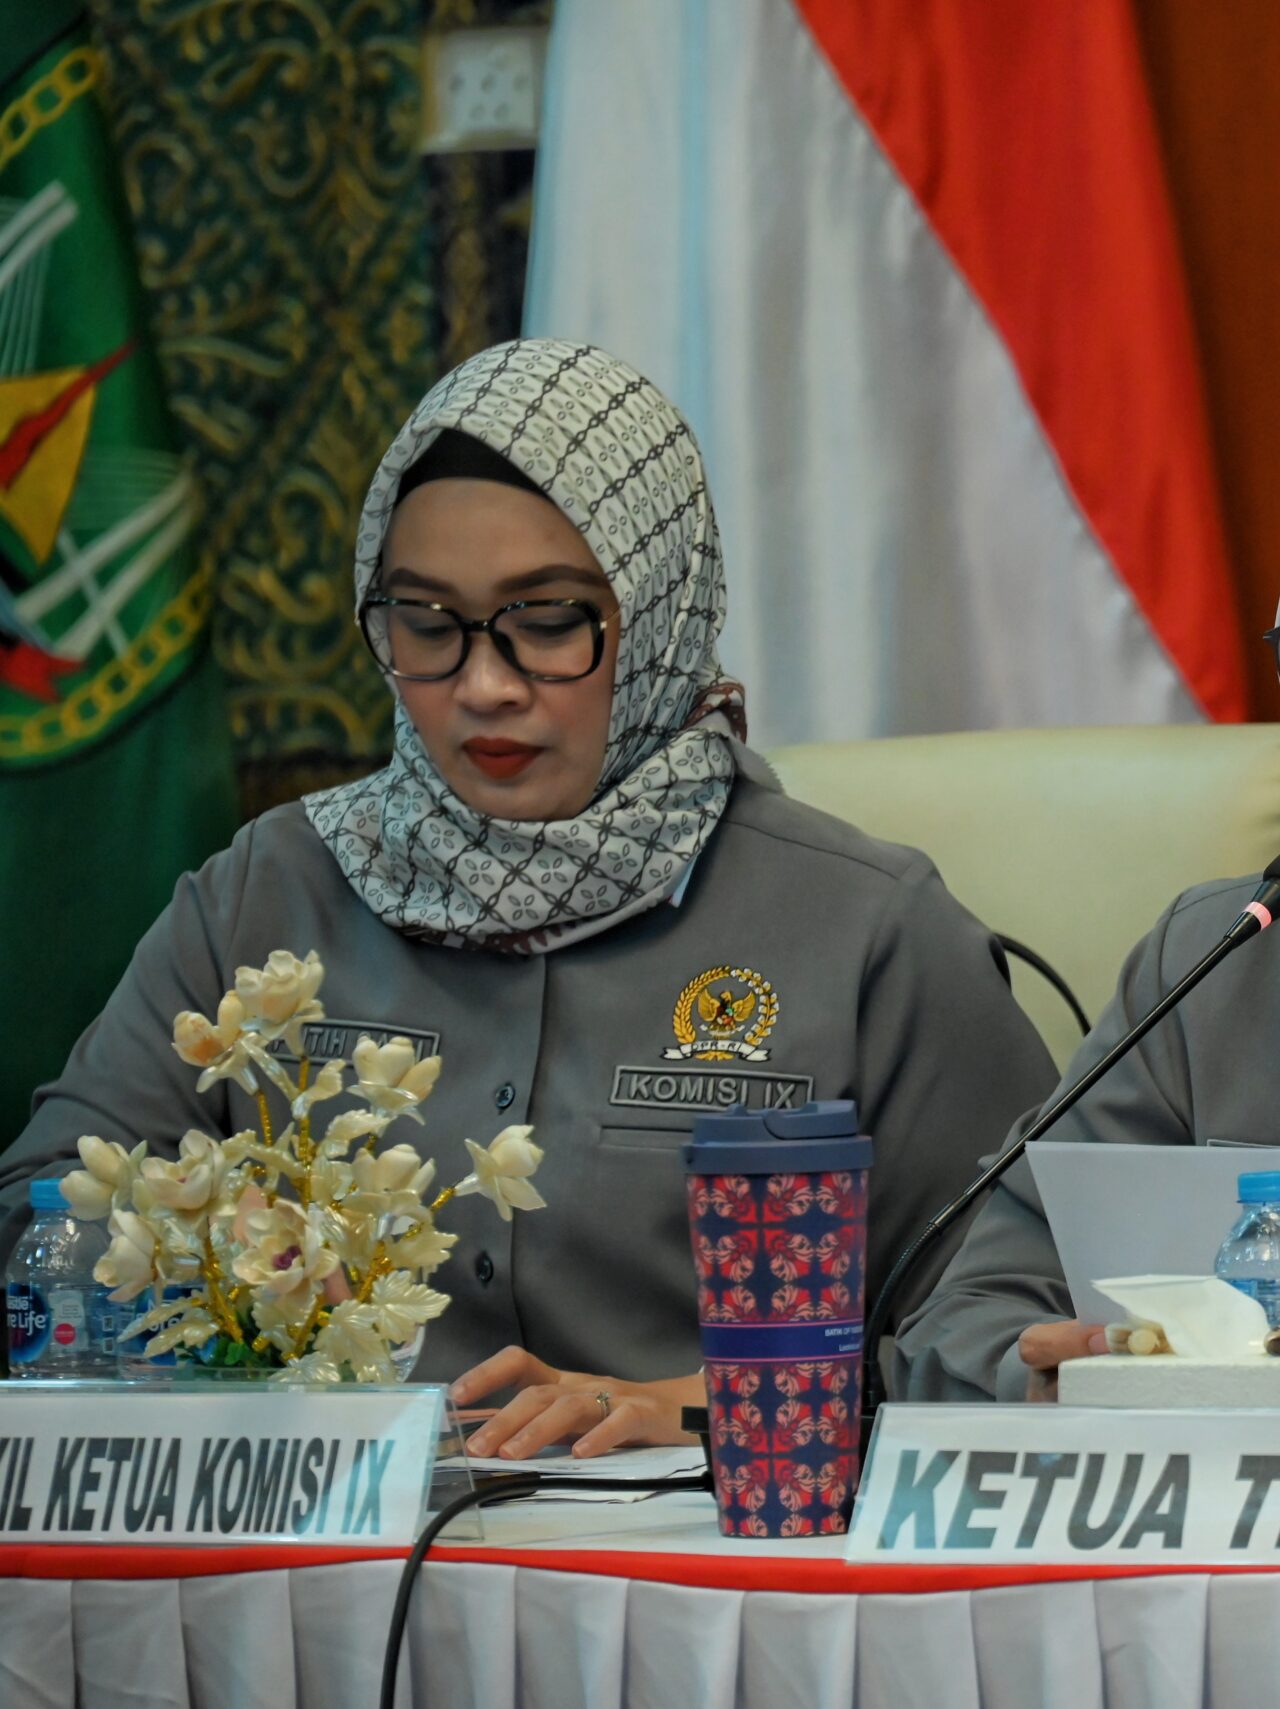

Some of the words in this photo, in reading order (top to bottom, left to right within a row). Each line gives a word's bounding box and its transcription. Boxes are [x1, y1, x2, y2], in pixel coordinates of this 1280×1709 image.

[630, 1075, 748, 1107] KOMISI
[765, 1081, 796, 1109] IX
[42, 1437, 181, 1533] KETUA
[186, 1437, 340, 1534] KOMISI
[341, 1439, 394, 1534] IX
[876, 1450, 1190, 1549] KETUA
